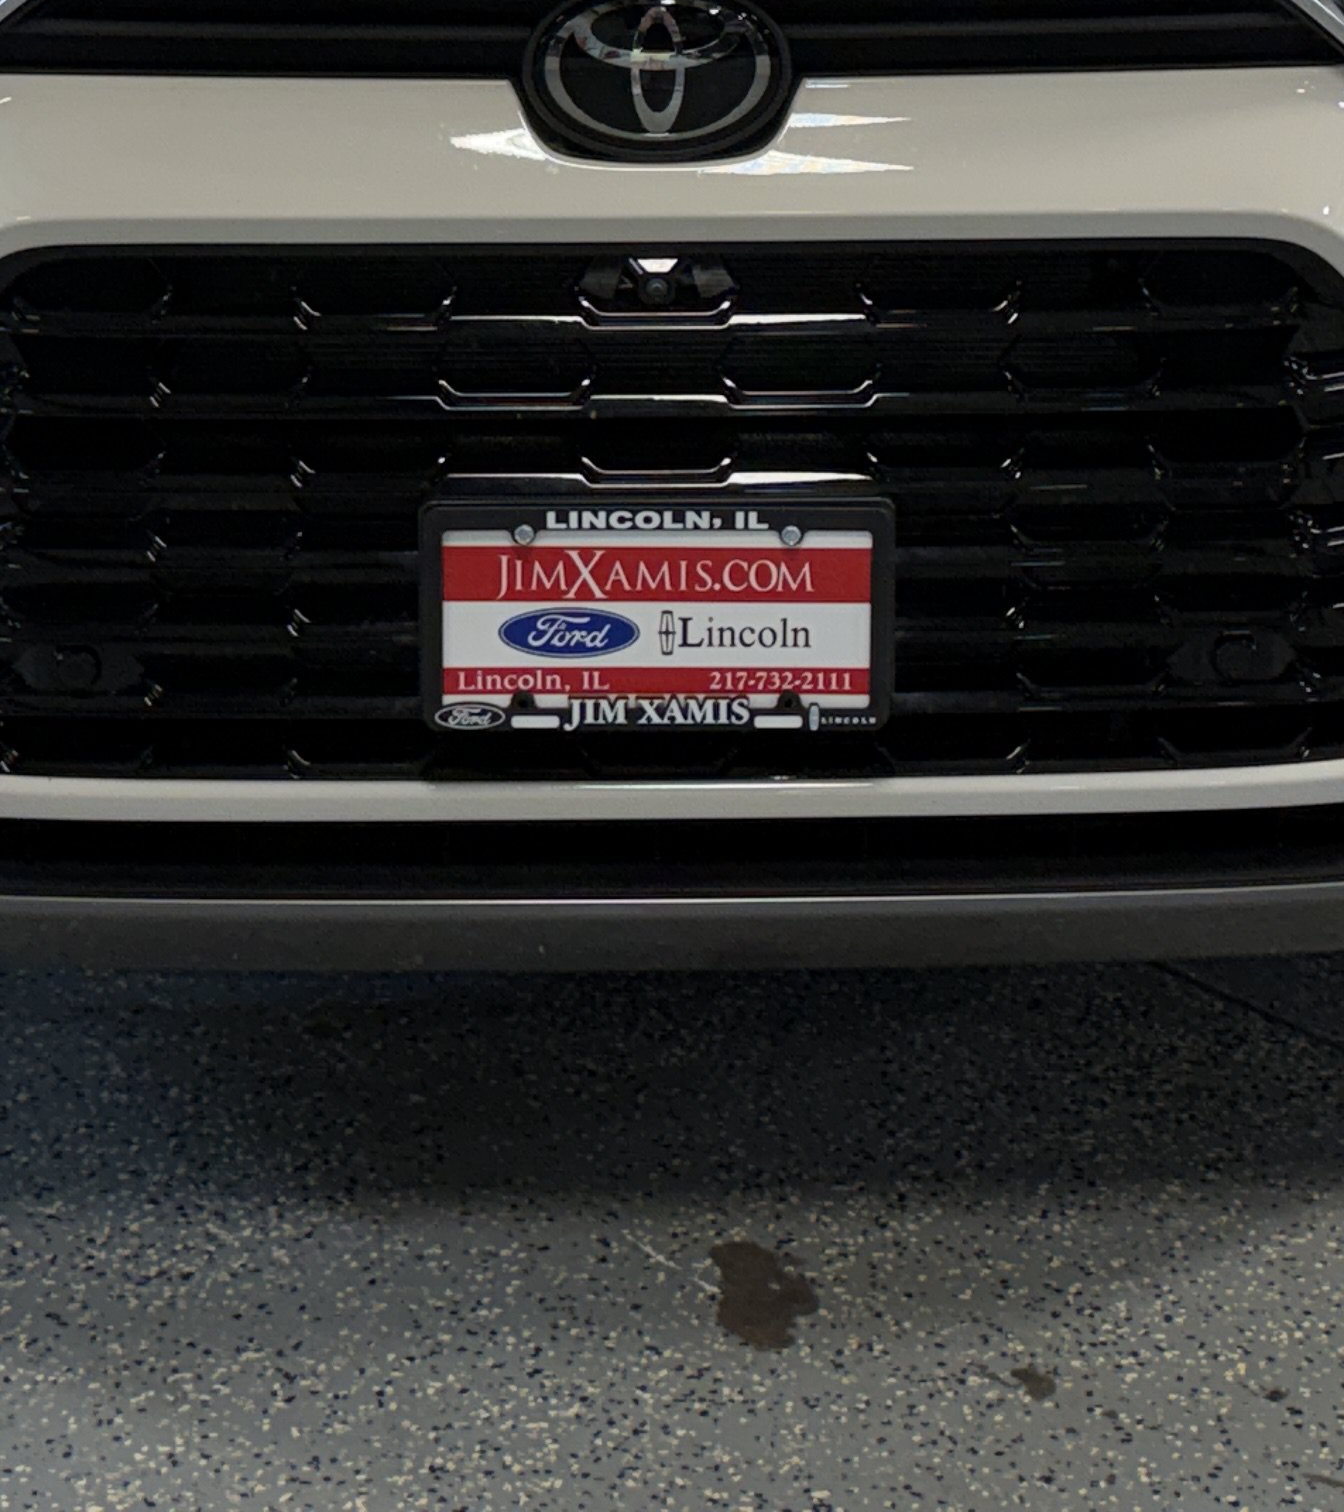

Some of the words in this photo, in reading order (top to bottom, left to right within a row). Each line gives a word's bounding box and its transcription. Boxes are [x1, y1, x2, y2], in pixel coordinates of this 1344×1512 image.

[546, 510, 722, 530] LINCOLN,
[735, 510, 769, 530] IL
[527, 615, 609, 648] Ford
[678, 617, 811, 649] Lincoln
[457, 671, 571, 692] Lincoln,
[582, 671, 610, 690] IL
[709, 672, 851, 690] 217-732-2111
[563, 697, 629, 731] JIM
[637, 696, 751, 726] XAMIS
